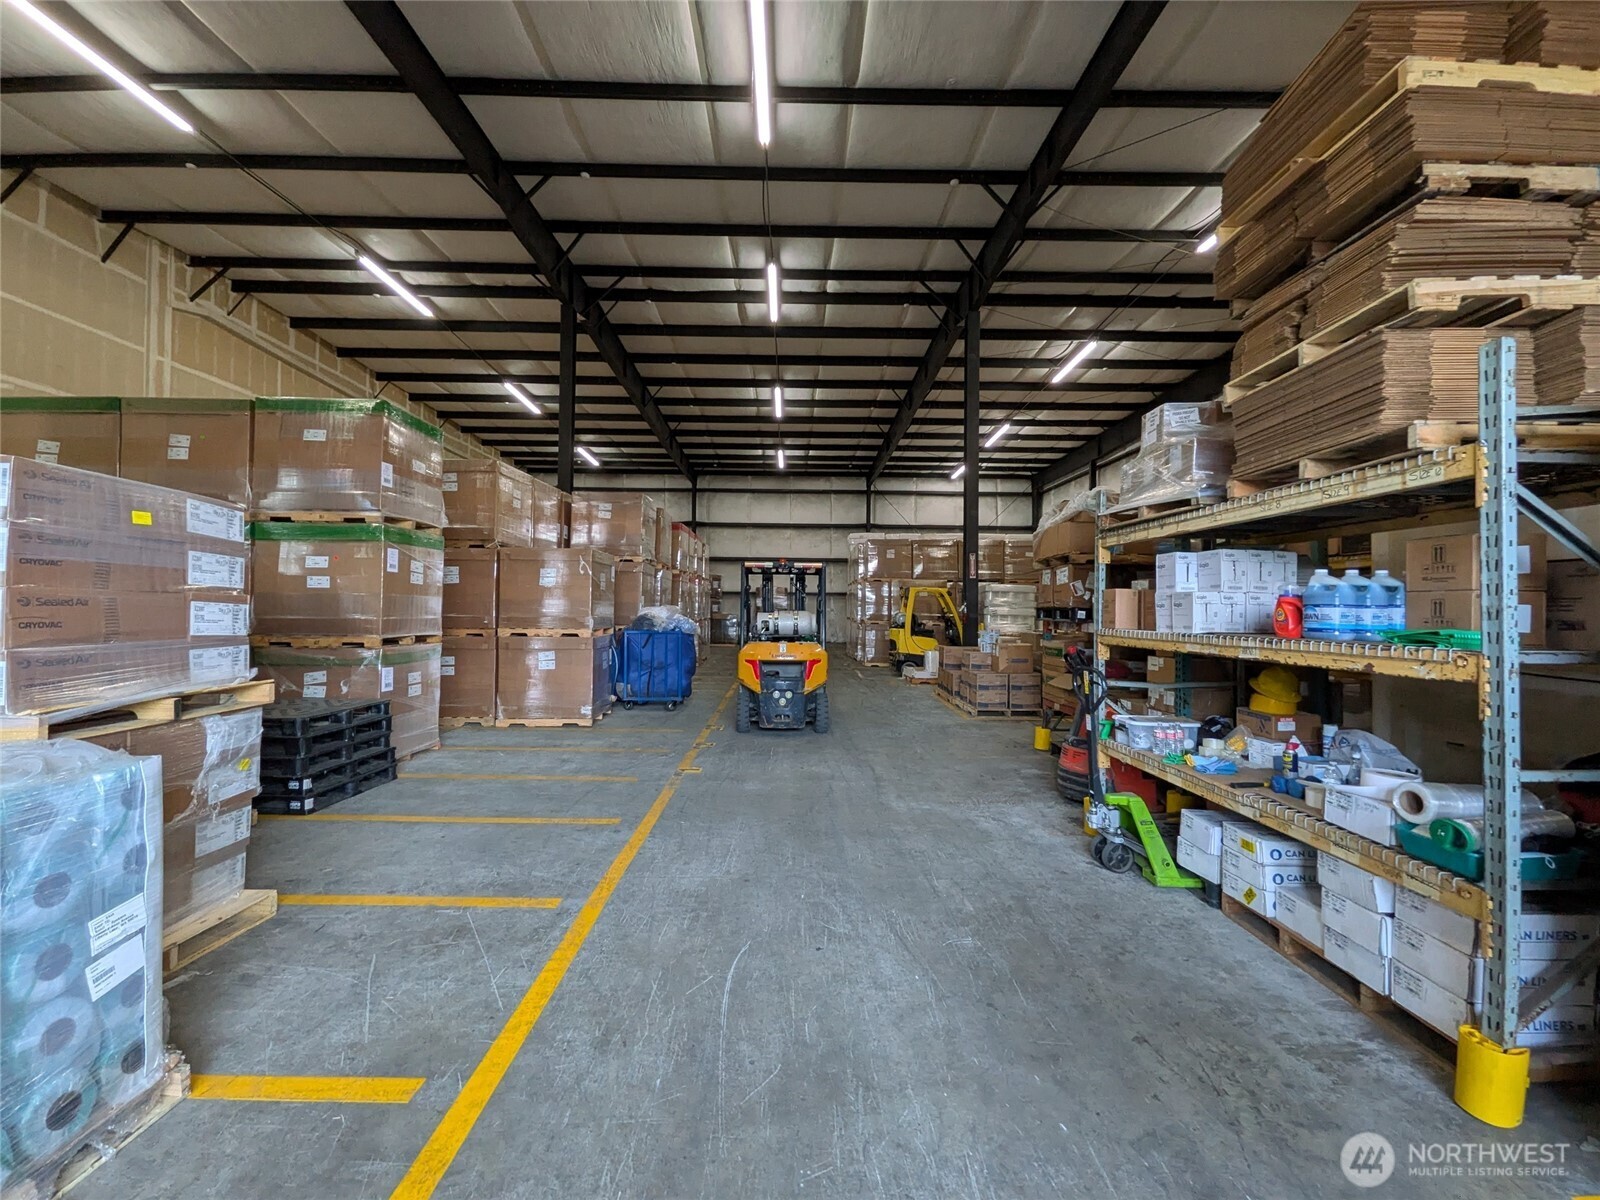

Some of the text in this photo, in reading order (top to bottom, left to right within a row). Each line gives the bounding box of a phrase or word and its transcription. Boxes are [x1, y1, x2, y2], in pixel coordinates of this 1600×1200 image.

[1408, 467, 1433, 482] SIZE
[1322, 484, 1350, 500] SIZE 9
[1275, 499, 1281, 509] 8
[19, 557, 63, 567] CRYOVAC
[35, 597, 89, 607] Sealed Air
[18, 621, 63, 630] CRYOVAC
[36, 656, 75, 667] Sealed
[1284, 849, 1305, 858] CAN
[1287, 874, 1306, 882] CAN
[1536, 930, 1577, 941] LINERS
[1533, 1020, 1575, 1032] LINERS
